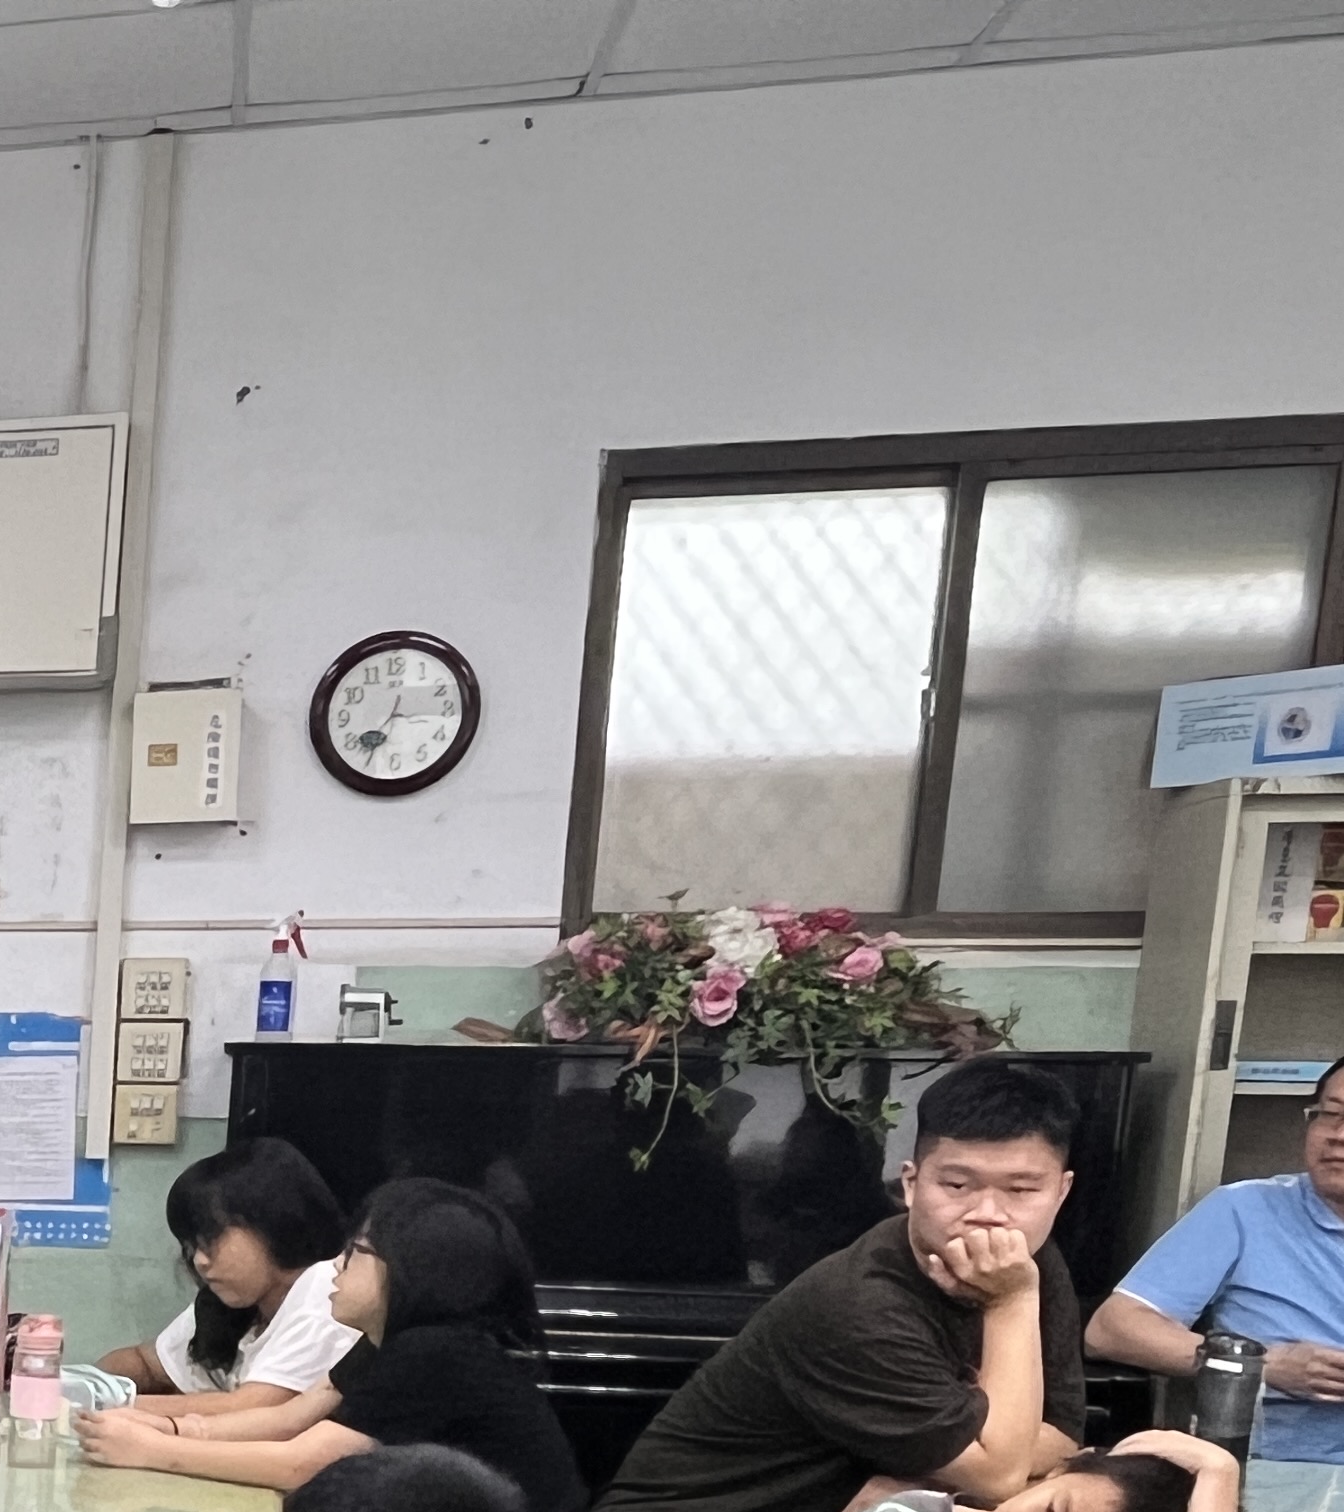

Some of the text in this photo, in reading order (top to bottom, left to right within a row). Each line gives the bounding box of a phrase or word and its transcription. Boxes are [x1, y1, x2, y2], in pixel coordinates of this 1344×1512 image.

[363, 665, 382, 685] 11
[344, 686, 365, 706] 10
[337, 709, 351, 728] 9
